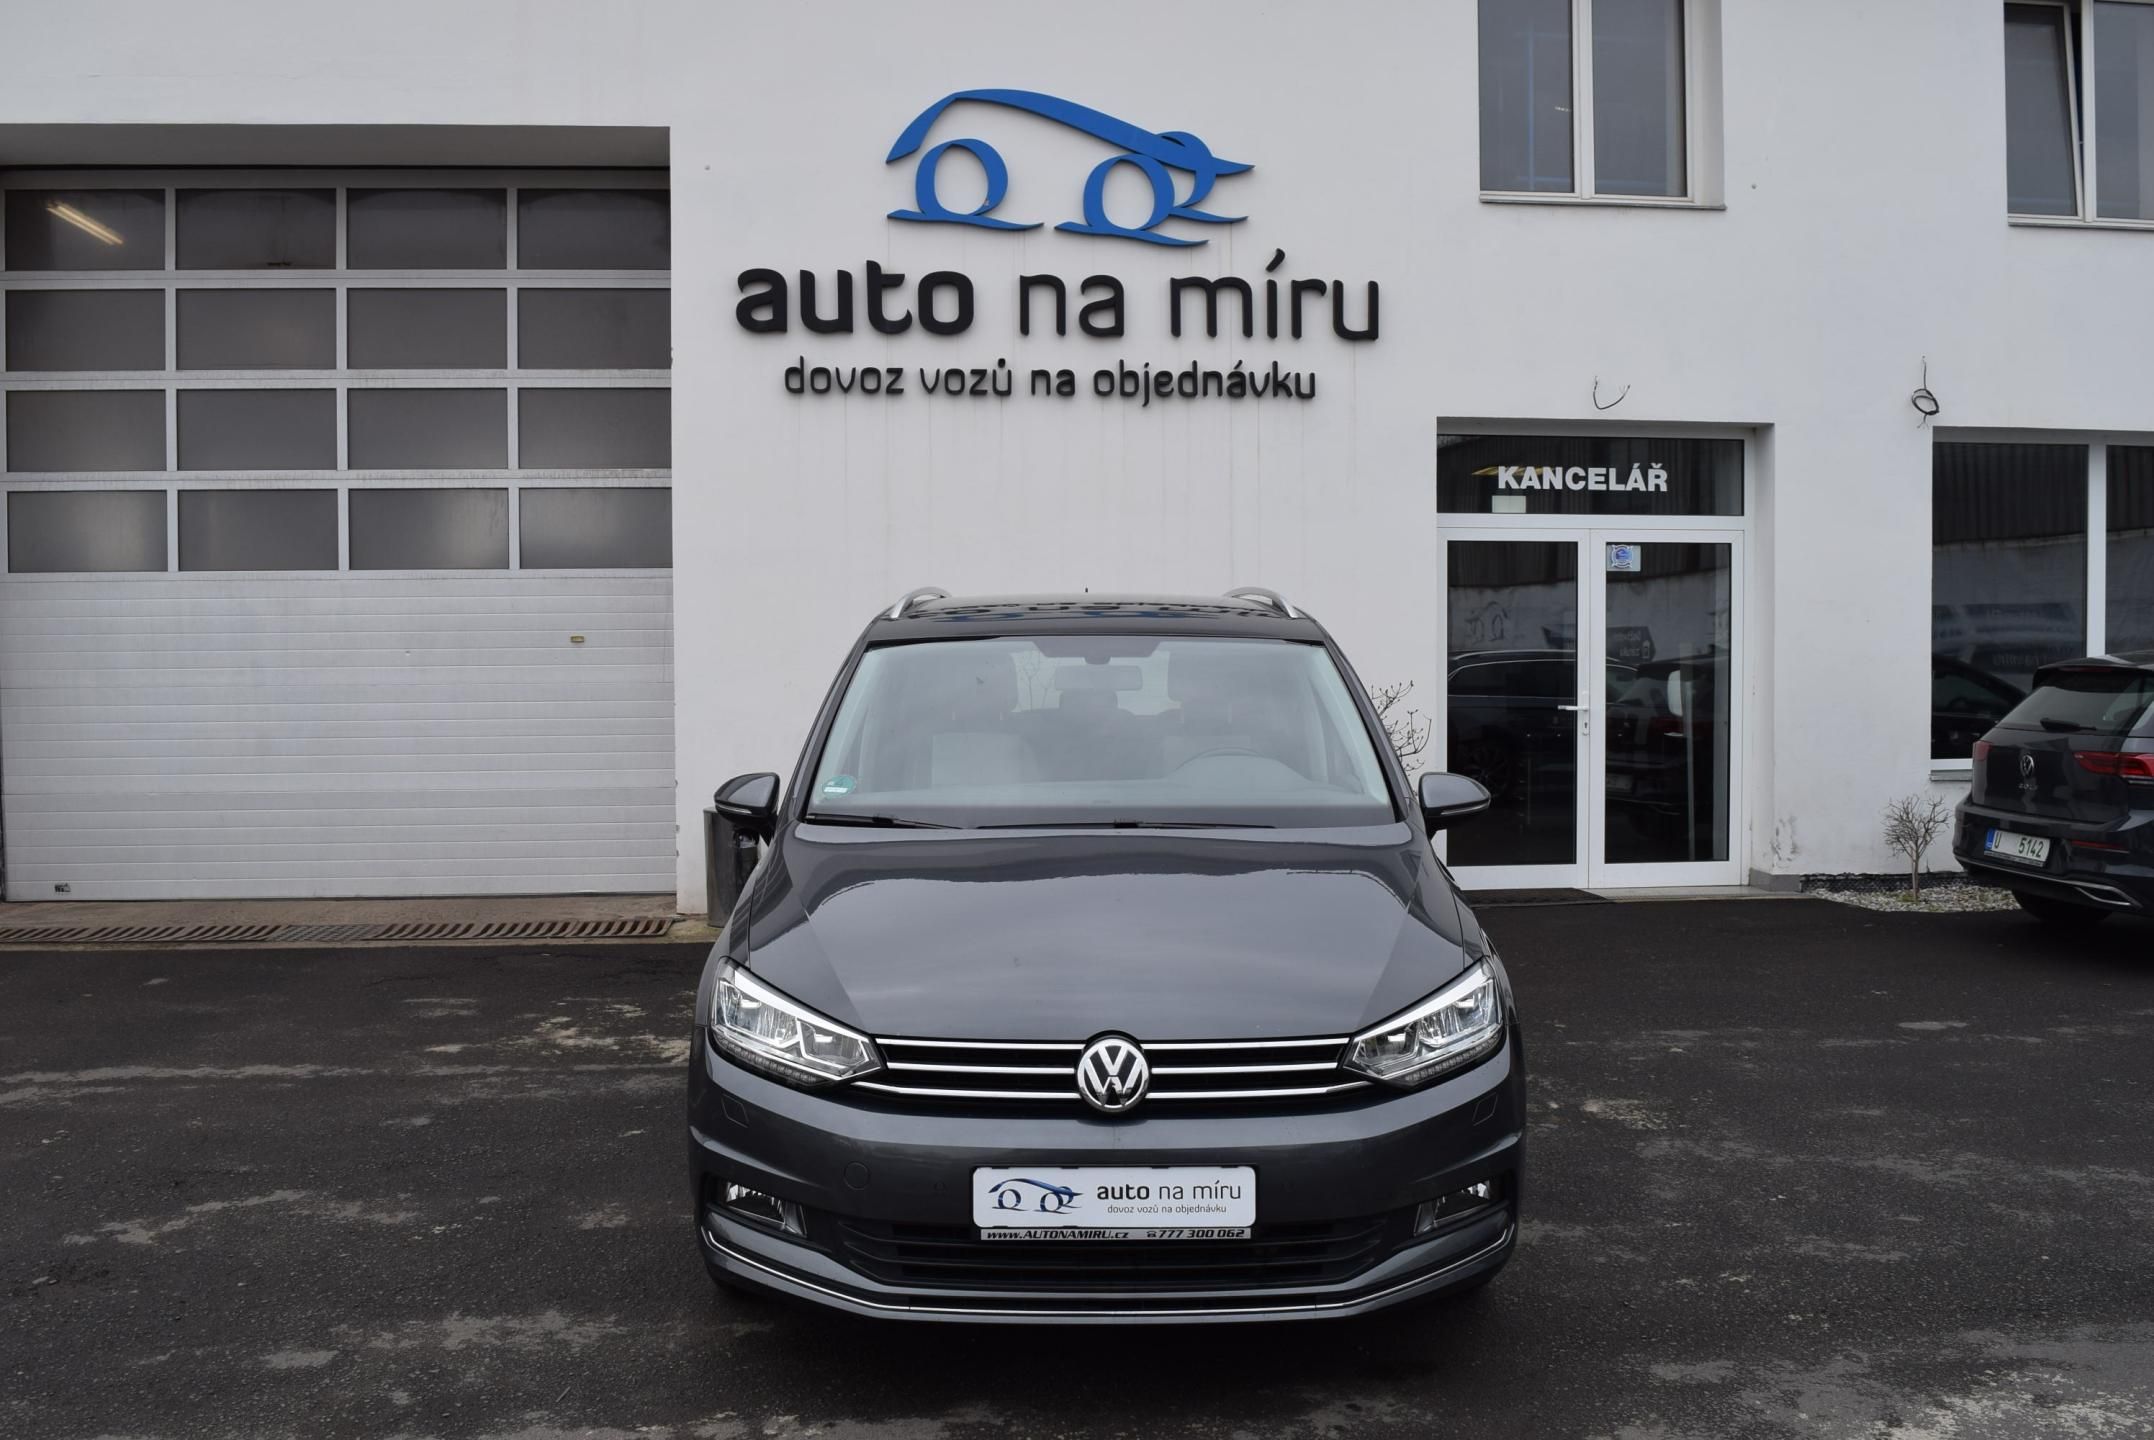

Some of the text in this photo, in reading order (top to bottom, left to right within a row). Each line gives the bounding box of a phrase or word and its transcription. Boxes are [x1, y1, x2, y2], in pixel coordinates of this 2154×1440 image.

[735, 248, 1380, 341] auto na míru
[784, 355, 1317, 408] dovoz vozů na objednávku
[1498, 462, 1669, 492] KANCELÁŘ
[2018, 837, 2044, 859] 5142
[1097, 1179, 1241, 1200] auto na míru
[1107, 1203, 1227, 1215] dovoz vozů na objednávku
[987, 1230, 1129, 1239] www.AUTONAMIRU.cz
[1159, 1229, 1245, 1238] 777 300 062
